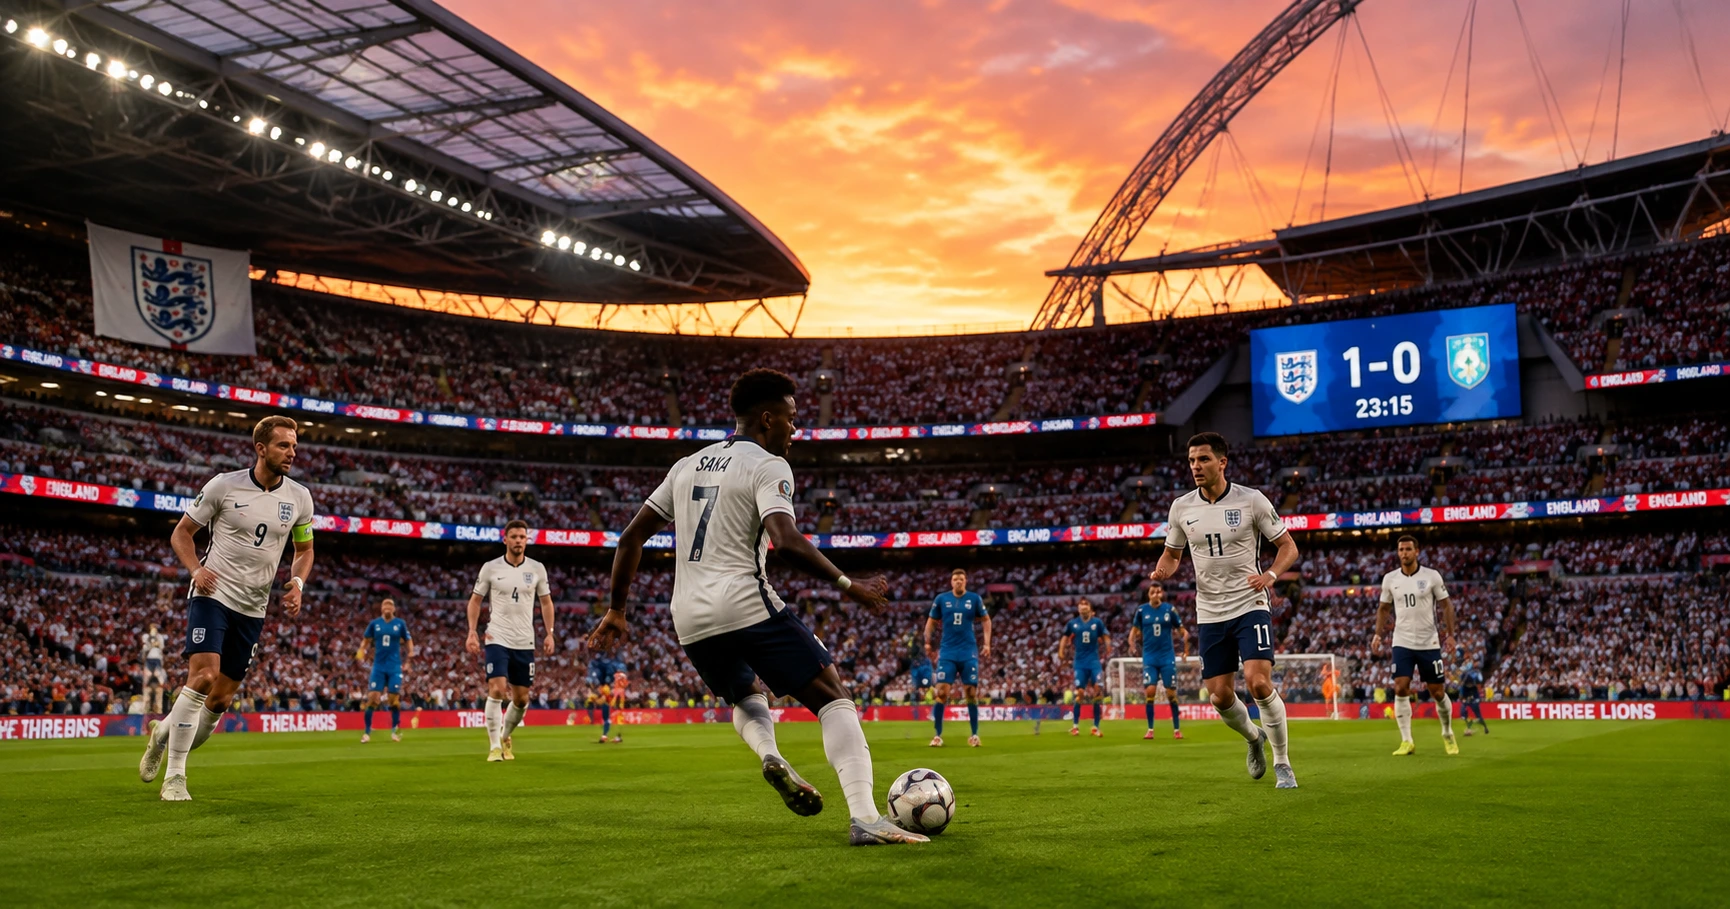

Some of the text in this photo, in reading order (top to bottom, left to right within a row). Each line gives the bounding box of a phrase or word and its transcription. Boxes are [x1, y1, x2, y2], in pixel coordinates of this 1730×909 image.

[1342, 341, 1420, 388] 1-0
[1355, 394, 1413, 419] 23:15
[695, 456, 732, 473] SAKA
[1649, 492, 1707, 510] ENGLAND
[1443, 505, 1496, 521] ENGLAND
[687, 485, 719, 562] 7
[254, 523, 268, 547] 9
[1204, 533, 1222, 556] 11
[511, 587, 519, 603] 4
[1404, 593, 1416, 608] 10
[1253, 624, 1271, 646] 11
[1497, 703, 1656, 720] THE THREE LIONS
